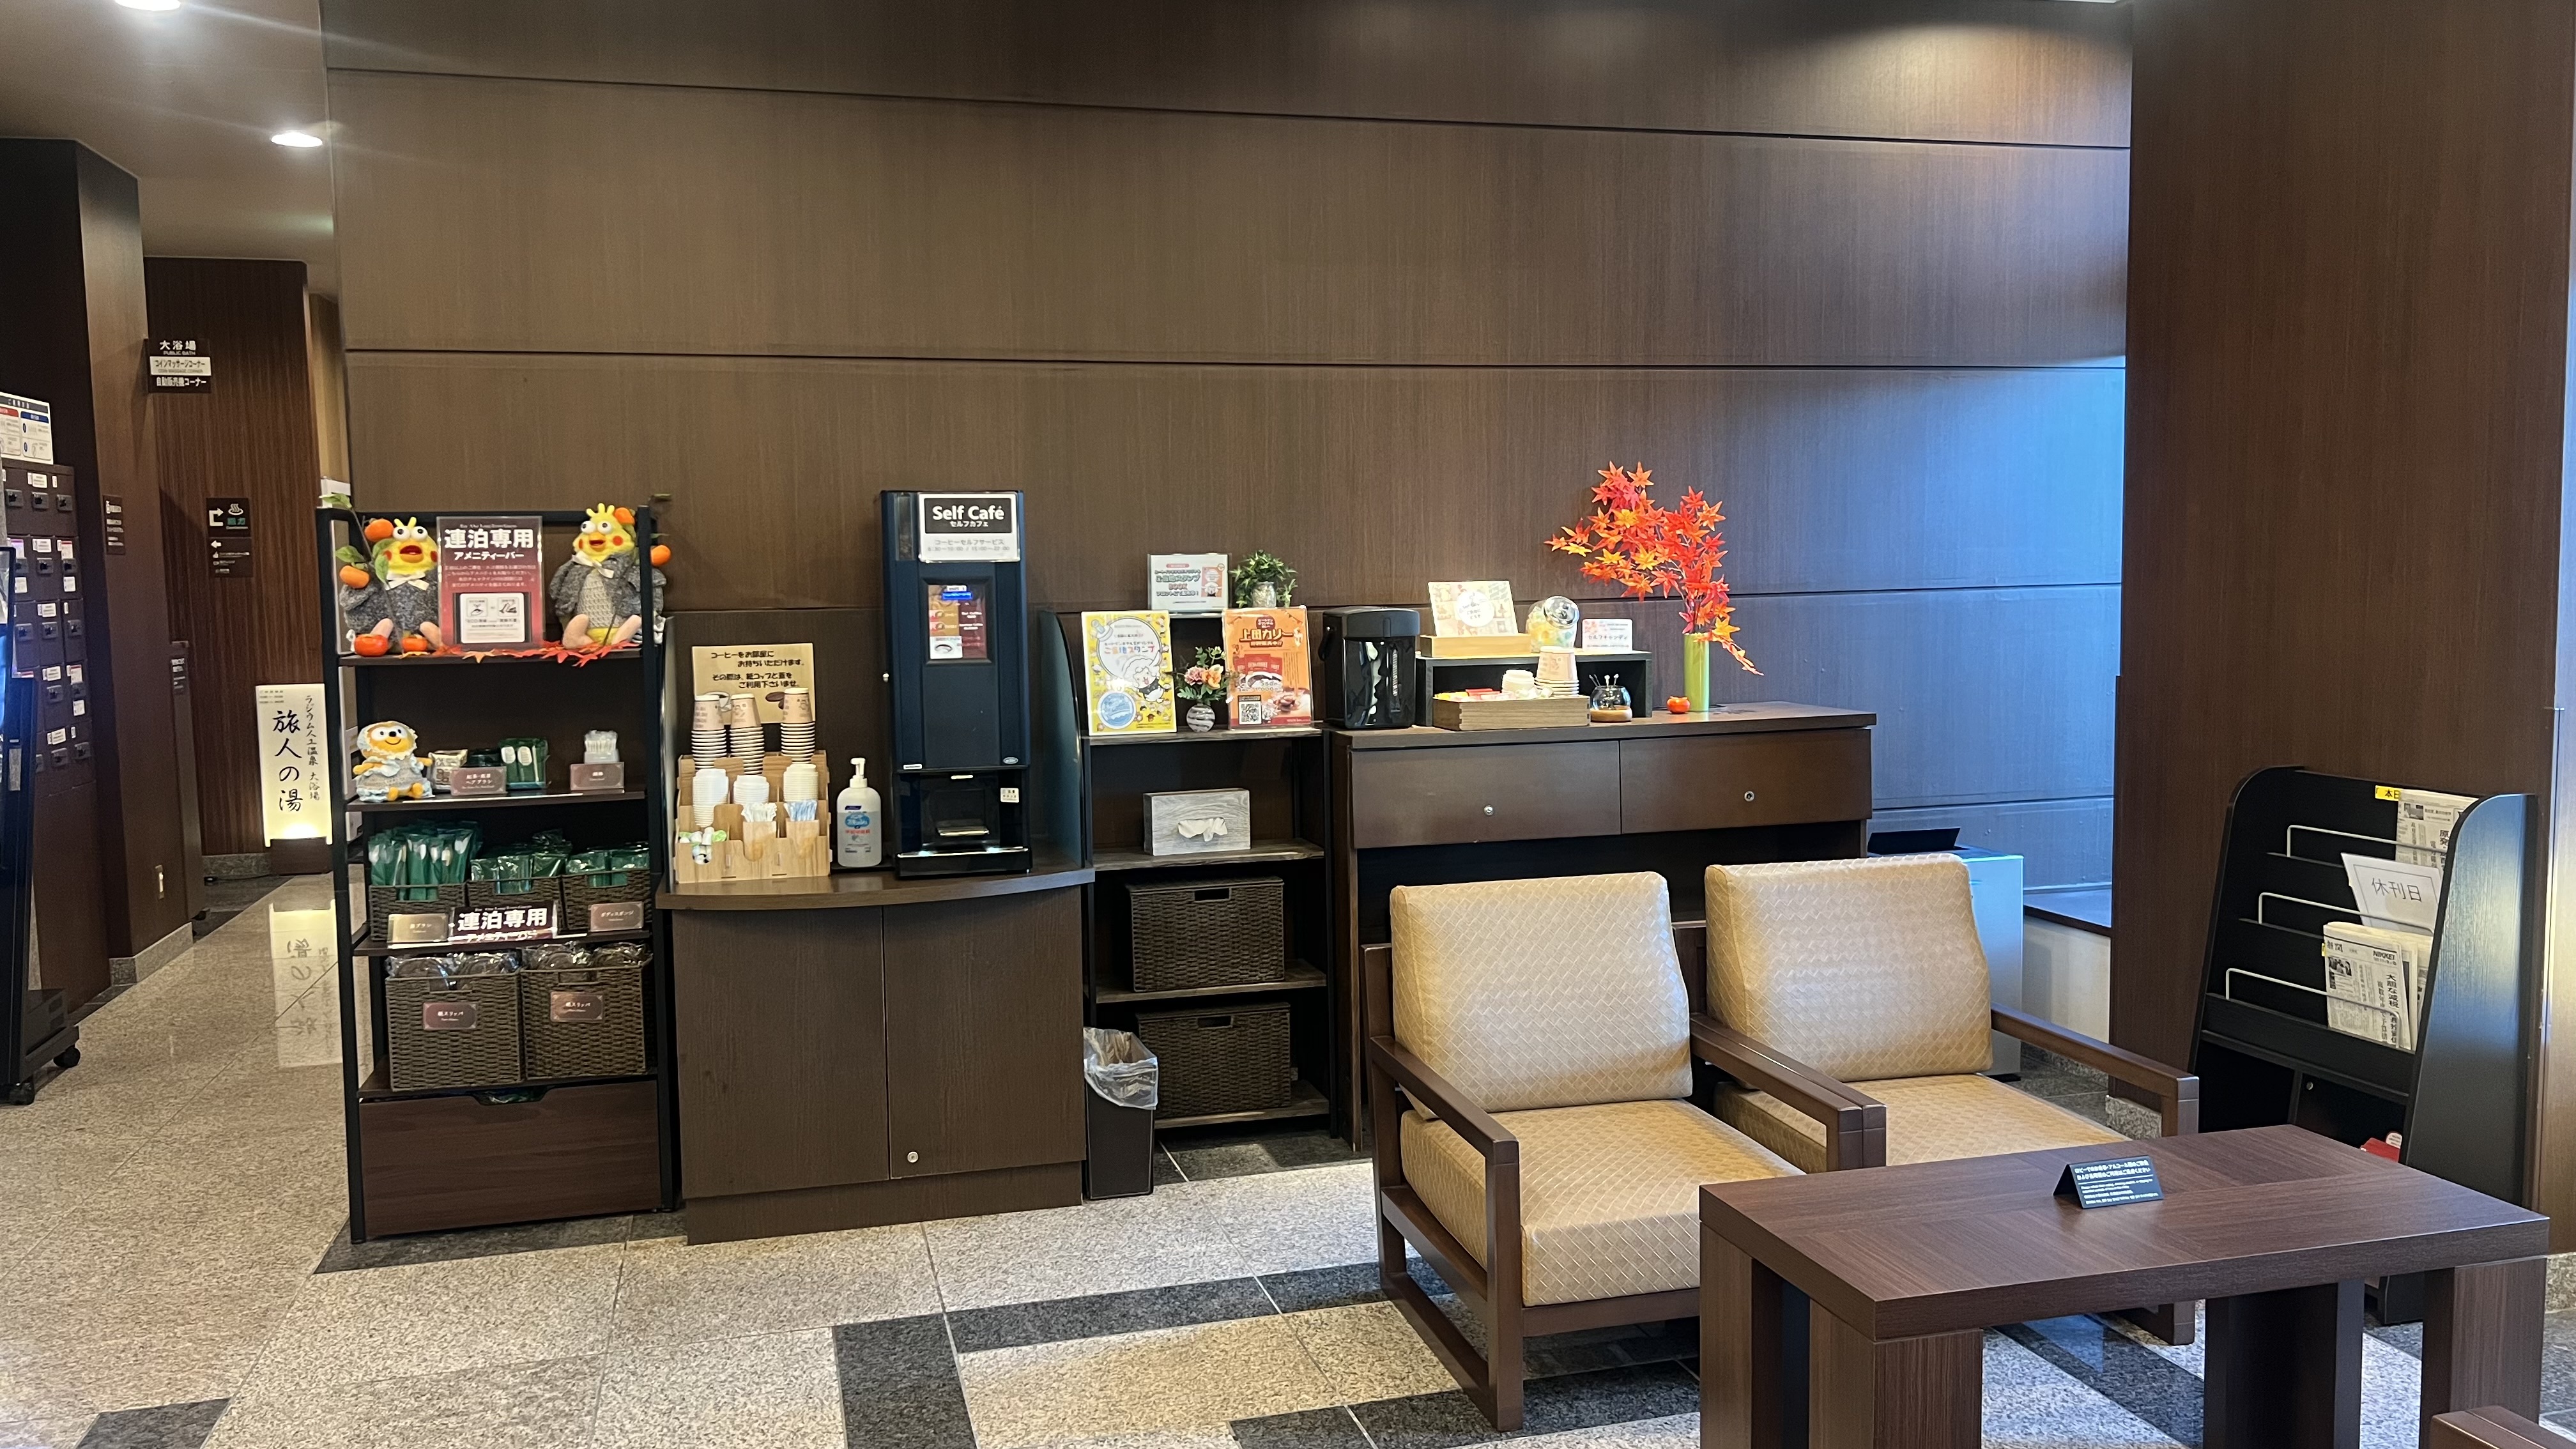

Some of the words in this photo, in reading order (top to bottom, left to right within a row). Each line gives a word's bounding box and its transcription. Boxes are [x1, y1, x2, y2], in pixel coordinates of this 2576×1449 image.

[159, 340, 196, 351] 大浴場
[155, 359, 206, 369] コインマッサージコーナー
[932, 505, 965, 520] Self
[967, 505, 1005, 520] Café
[444, 528, 534, 549] 連泊専用
[454, 551, 525, 561] アメニティーバー
[1239, 628, 1294, 642] 上田カリー
[711, 650, 774, 659] コーヒーをお部屋に
[737, 659, 805, 668] お持ちいただけます。
[305, 695, 318, 766] ラジウム人工温泉
[272, 709, 303, 812] 旅人の湯
[309, 771, 320, 801] 大浴場
[2384, 788, 2400, 800] 本日
[2371, 877, 2422, 903] 休刊日
[457, 907, 548, 931] 連泊専用
[2373, 950, 2395, 960] NIKKEI
